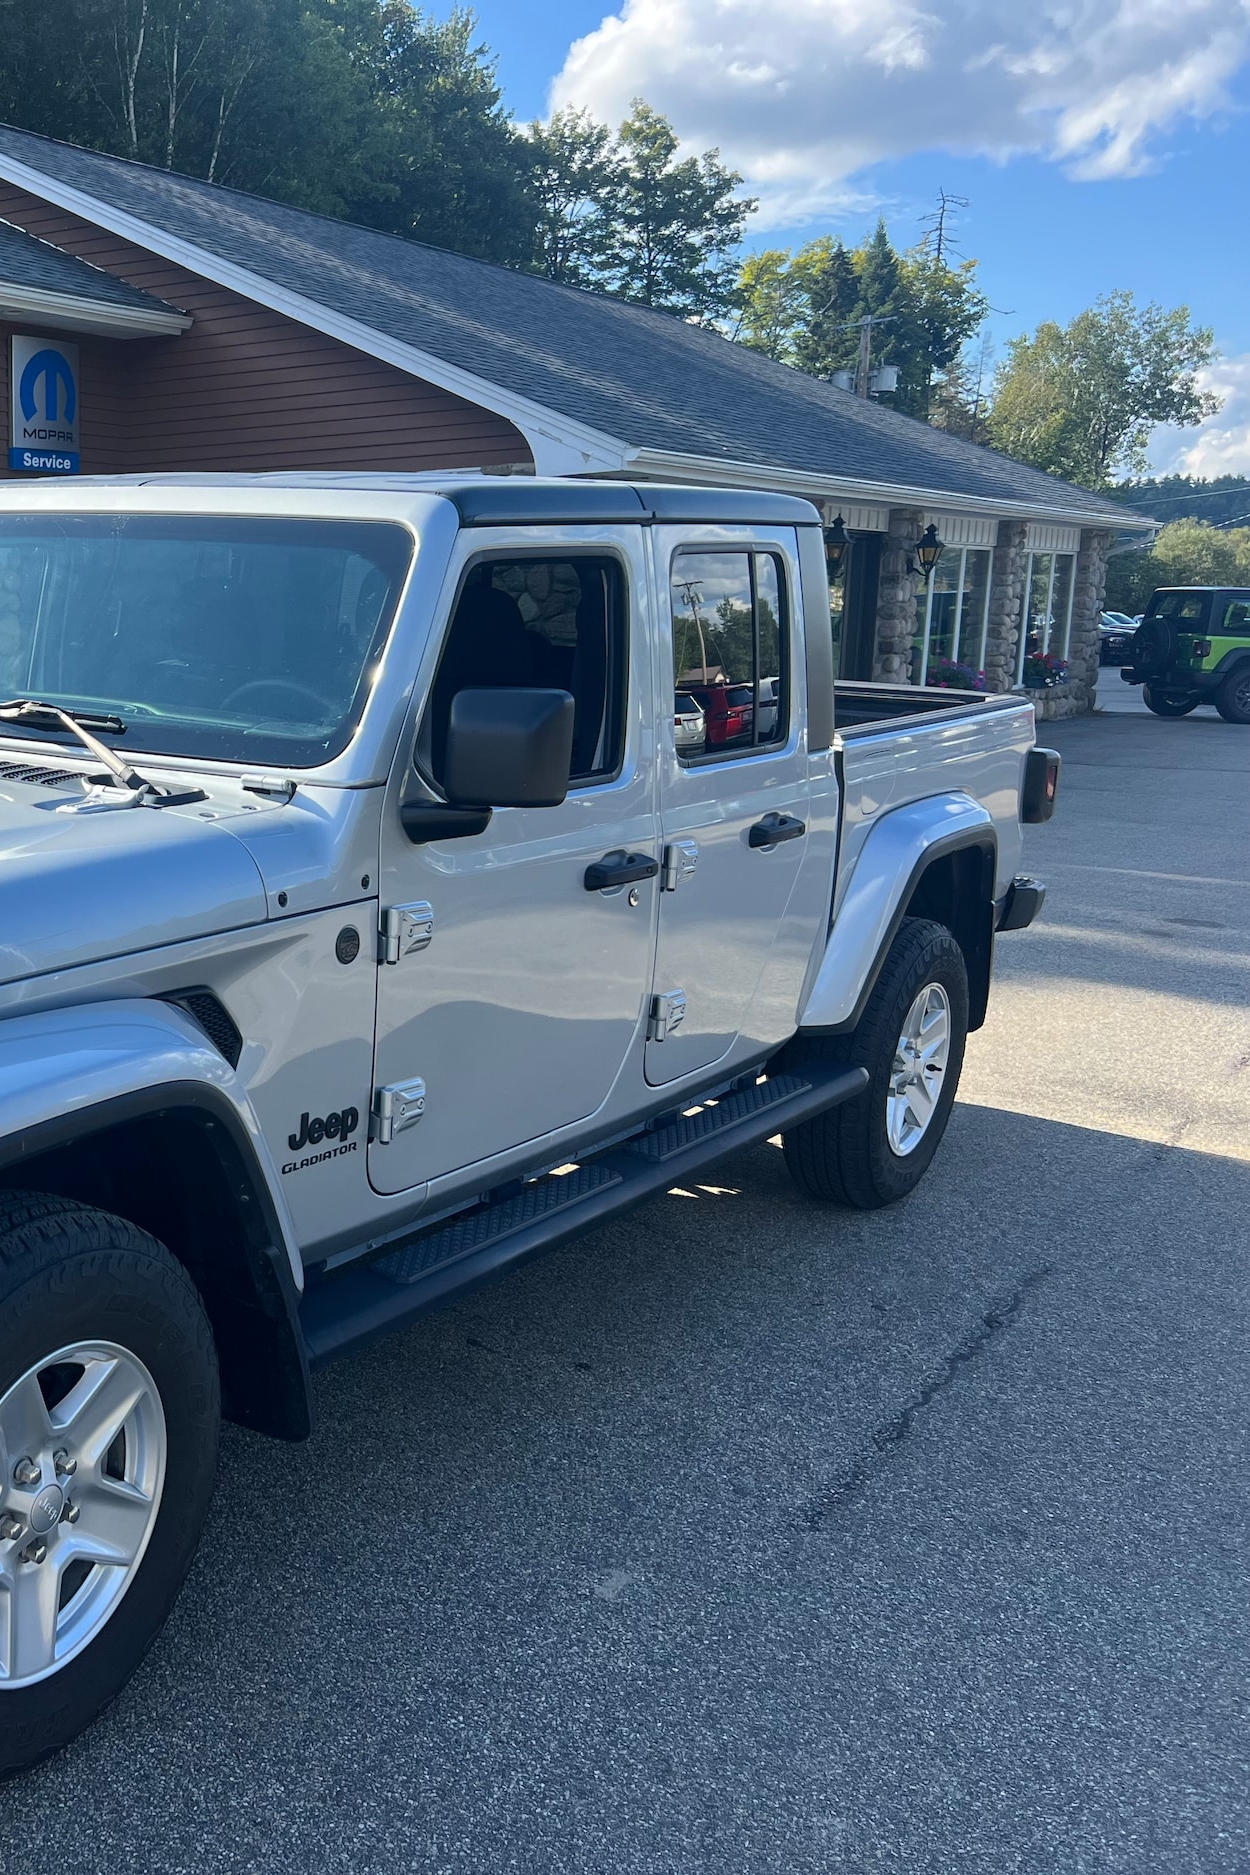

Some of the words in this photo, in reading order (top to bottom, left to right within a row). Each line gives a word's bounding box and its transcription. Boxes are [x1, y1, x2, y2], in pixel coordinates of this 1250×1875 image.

[23, 428, 74, 443] MOPAR
[23, 452, 71, 470] Service
[288, 1106, 359, 1151] Jeep
[281, 1141, 357, 1175] GLADIATOR
